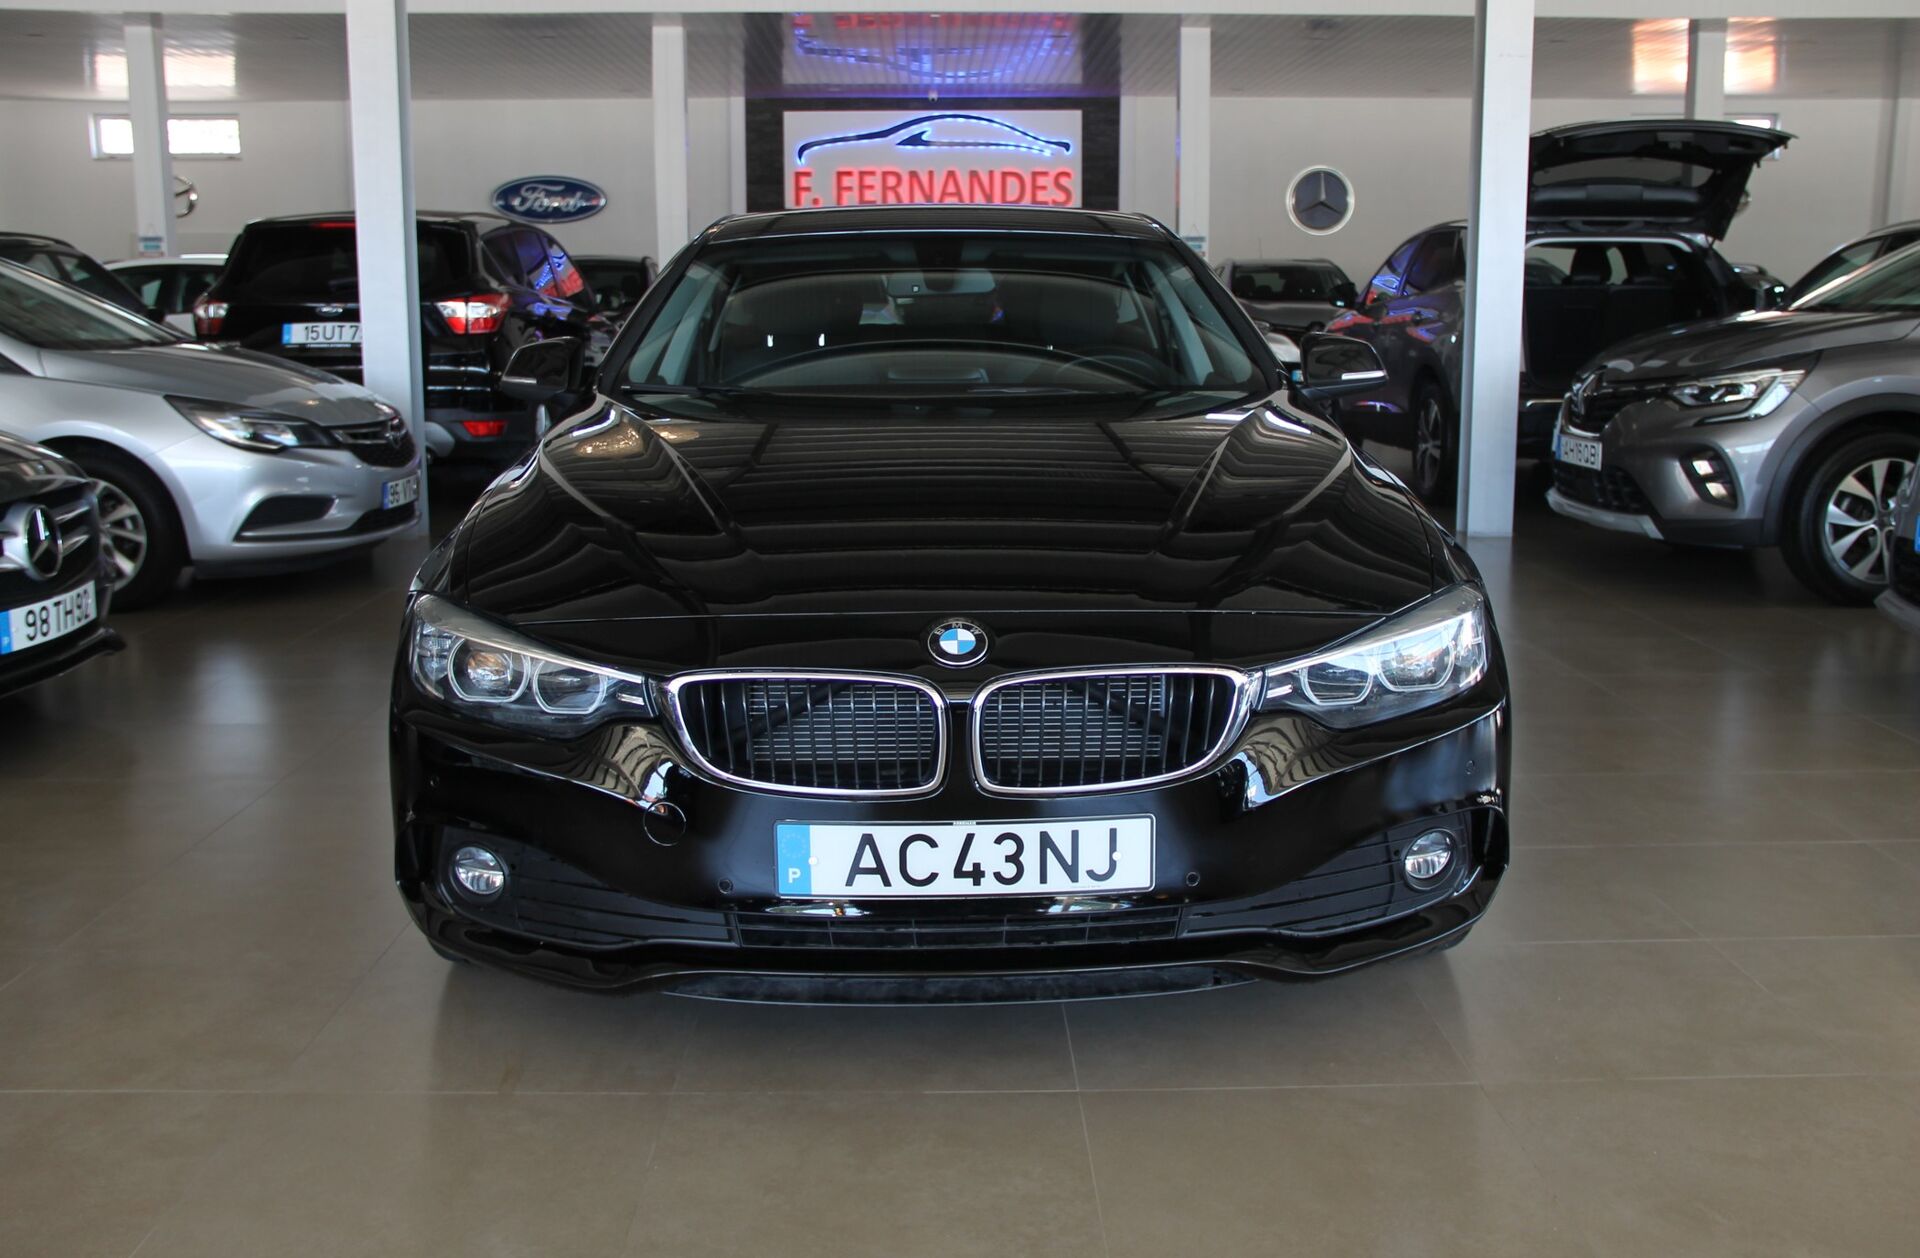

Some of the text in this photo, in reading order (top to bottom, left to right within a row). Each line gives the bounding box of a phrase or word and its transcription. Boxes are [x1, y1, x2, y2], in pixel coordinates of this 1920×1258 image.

[513, 183, 586, 213] Ford
[793, 169, 1073, 206] F. FERNANDES
[304, 325, 362, 341] 15UT7
[788, 868, 801, 884] P
